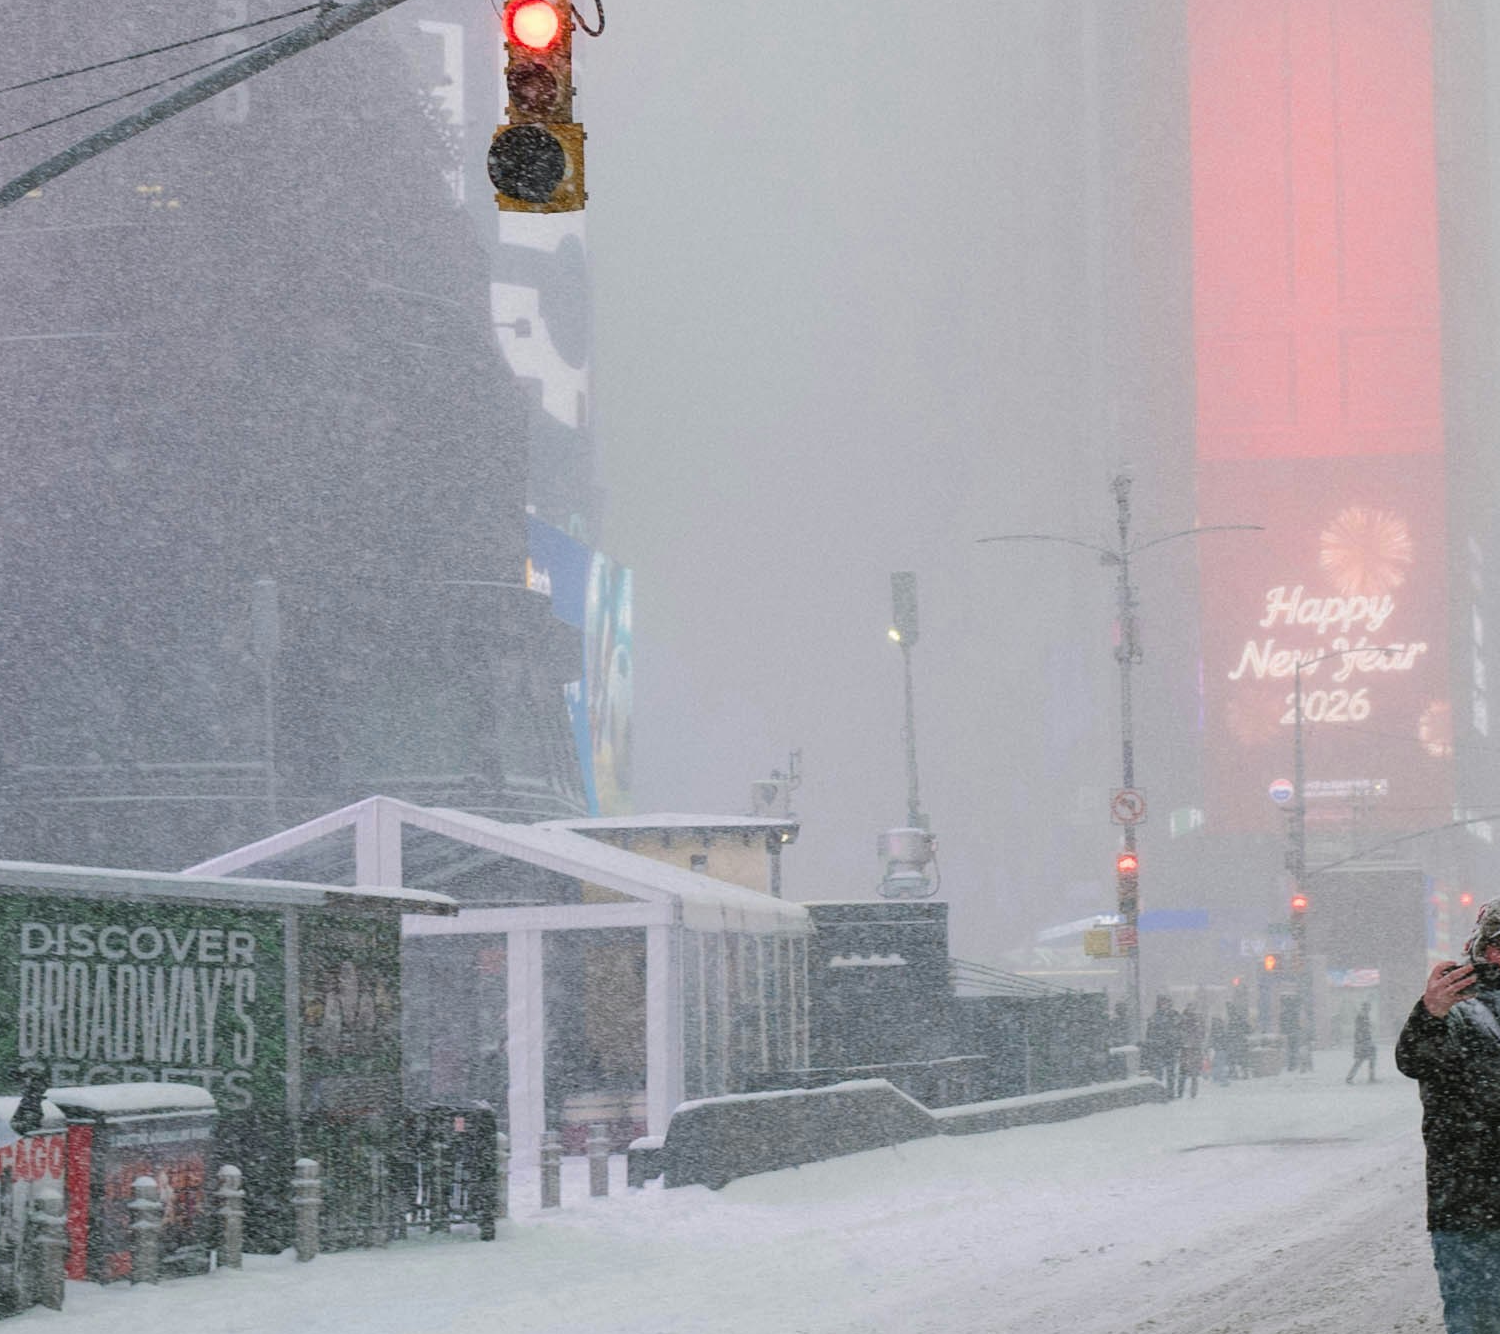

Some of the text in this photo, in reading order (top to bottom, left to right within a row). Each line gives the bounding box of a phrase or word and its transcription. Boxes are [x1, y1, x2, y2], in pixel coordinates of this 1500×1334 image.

[1259, 584, 1394, 634] Happy
[1228, 636, 1428, 682] New Year
[1279, 688, 1371, 725] 2026
[20, 921, 257, 964] DISCOVER
[18, 959, 257, 1066] BROADWAY'S
